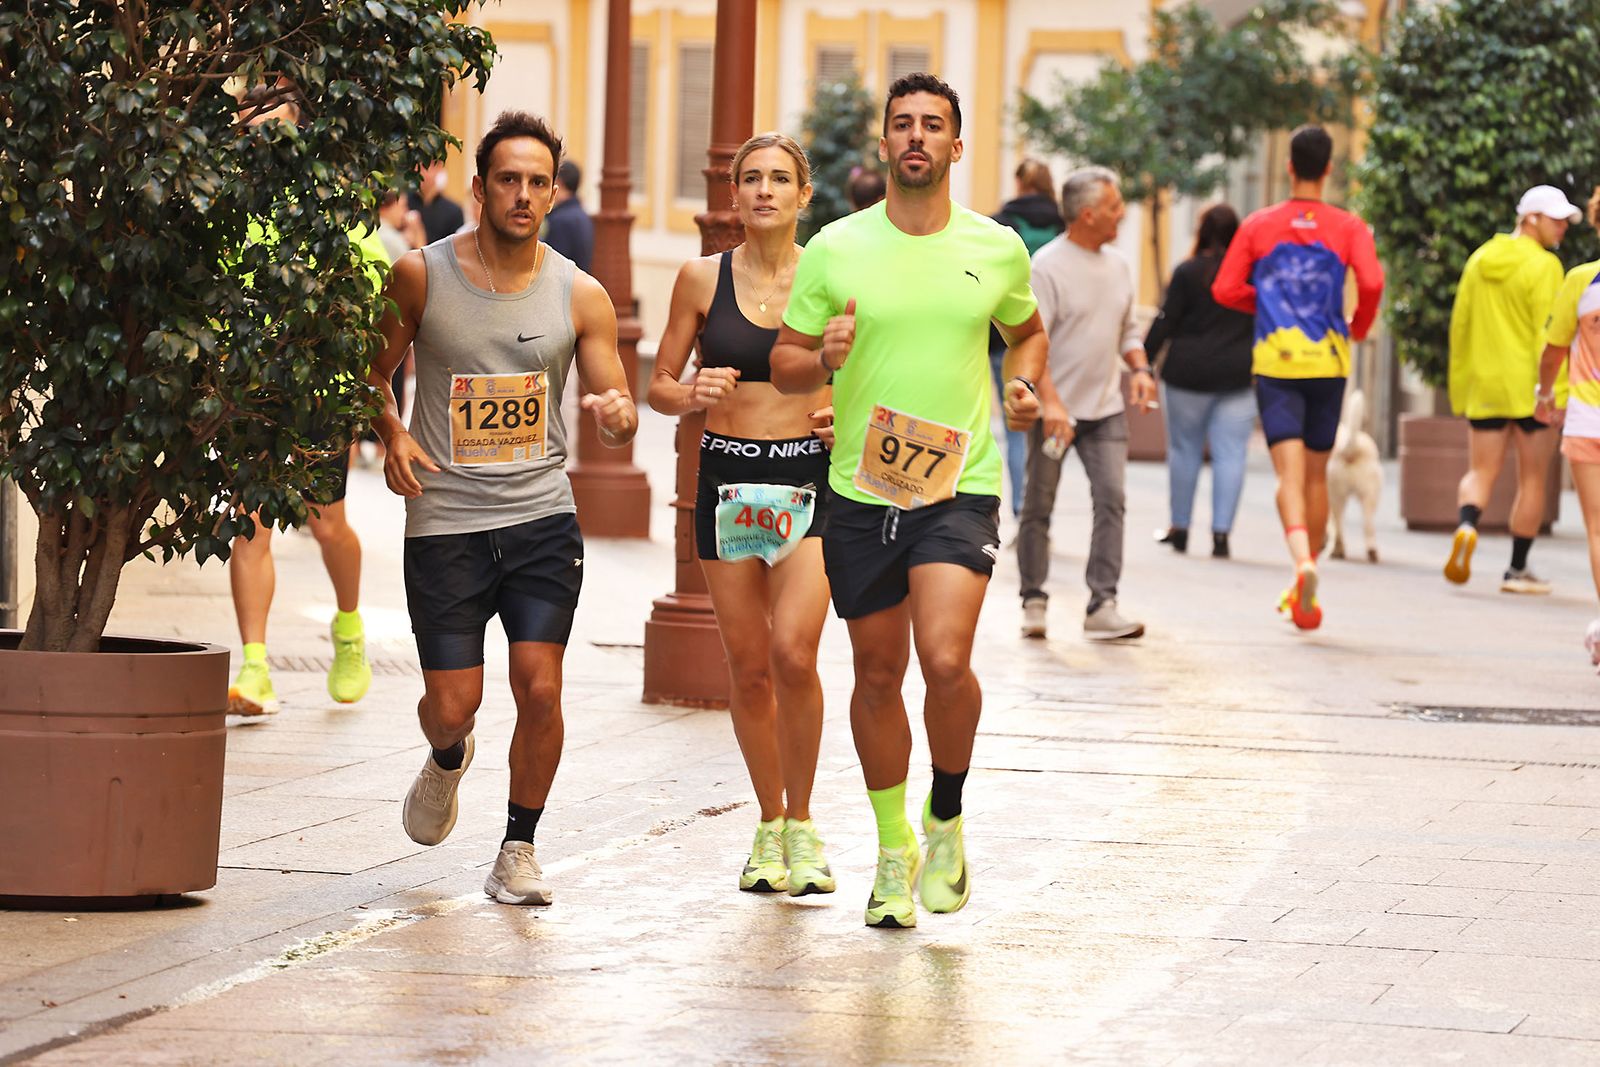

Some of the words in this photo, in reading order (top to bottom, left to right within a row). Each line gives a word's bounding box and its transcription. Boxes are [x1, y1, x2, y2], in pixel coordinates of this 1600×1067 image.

[458, 397, 540, 430] 1289
[457, 438, 496, 447] LOSADA
[497, 433, 537, 447] VAZQUEZ
[709, 438, 761, 458] PRO
[768, 439, 822, 459] NIKE
[879, 435, 947, 479] 977
[881, 472, 924, 495] CRUZADO
[734, 505, 792, 540] 460
